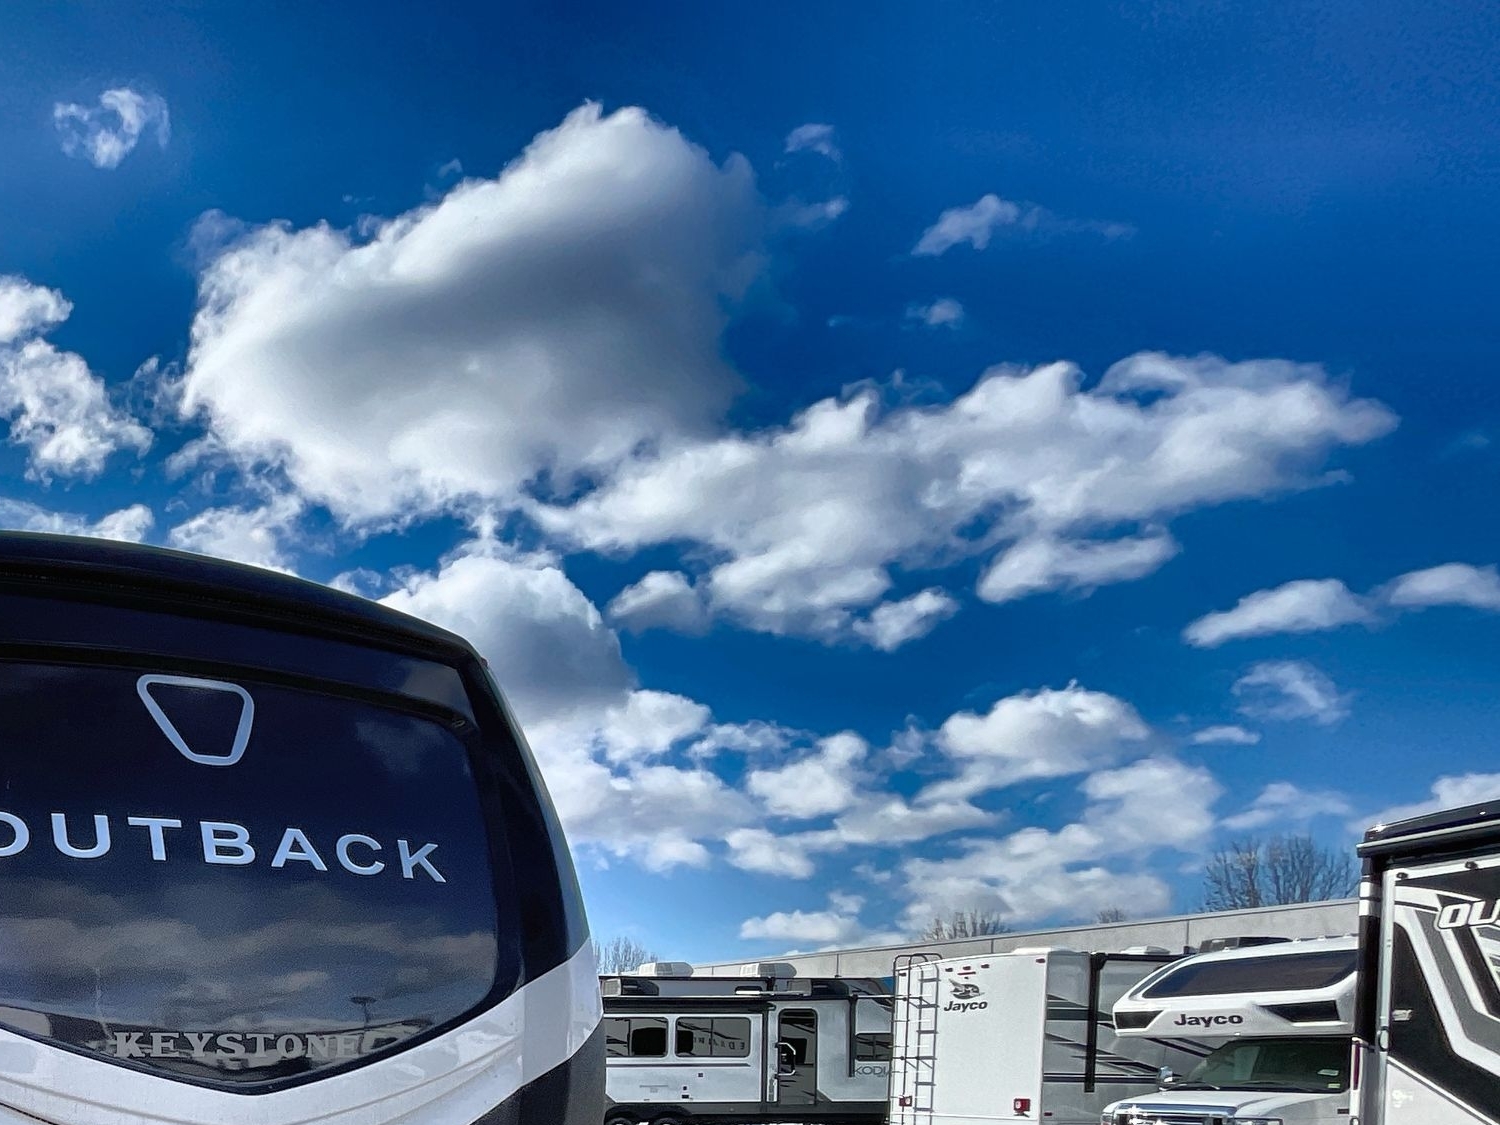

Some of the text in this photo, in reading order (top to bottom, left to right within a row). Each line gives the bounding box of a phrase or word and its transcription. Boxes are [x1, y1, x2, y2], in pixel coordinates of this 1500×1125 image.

[943, 999, 988, 1013] Jayco
[1173, 1012, 1244, 1028] Jayco
[113, 1031, 365, 1059] KEYSTONE
[855, 1065, 890, 1077] KODI
